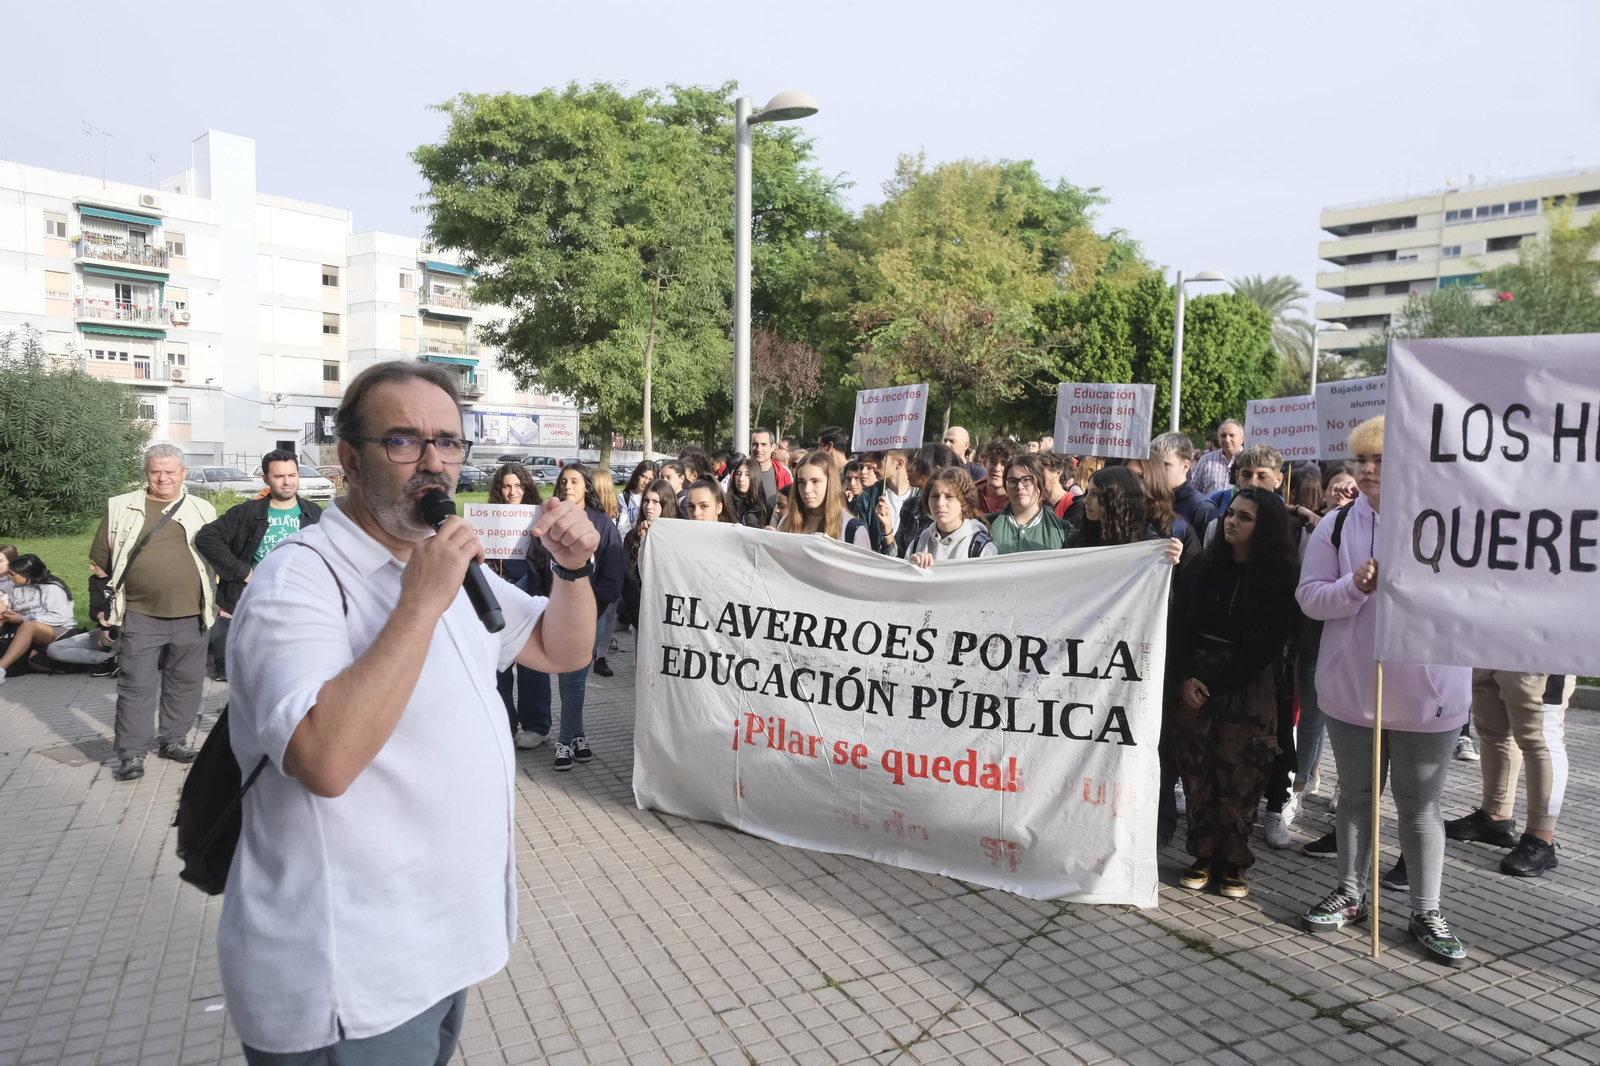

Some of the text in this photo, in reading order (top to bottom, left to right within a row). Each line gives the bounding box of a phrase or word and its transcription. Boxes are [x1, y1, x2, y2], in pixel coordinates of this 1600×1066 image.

[1073, 387, 1136, 400] Educación
[1330, 384, 1363, 395] Bajada
[1365, 382, 1378, 391] de
[861, 389, 921, 404] Los recortes
[1070, 403, 1135, 416] pública sin
[1253, 400, 1316, 415] Los recort
[1350, 399, 1386, 408] alumna
[859, 412, 919, 427] los pagamos
[1079, 419, 1122, 431] medios
[1326, 419, 1344, 430] No
[1251, 424, 1318, 437] los pagam
[1430, 403, 1531, 462] LOS
[866, 435, 908, 446] nosotras
[1067, 434, 1132, 447] suficientes
[1280, 446, 1316, 456] sotras
[470, 508, 534, 517] Los recortes
[487, 529, 533, 538] pagamos
[484, 547, 523, 556] osotras
[663, 594, 1143, 682] EL AVERROES POR LA
[660, 645, 1138, 747] EDUCACIÓN PÚBLICA
[732, 712, 1018, 793] ¡Pilar se queda!
